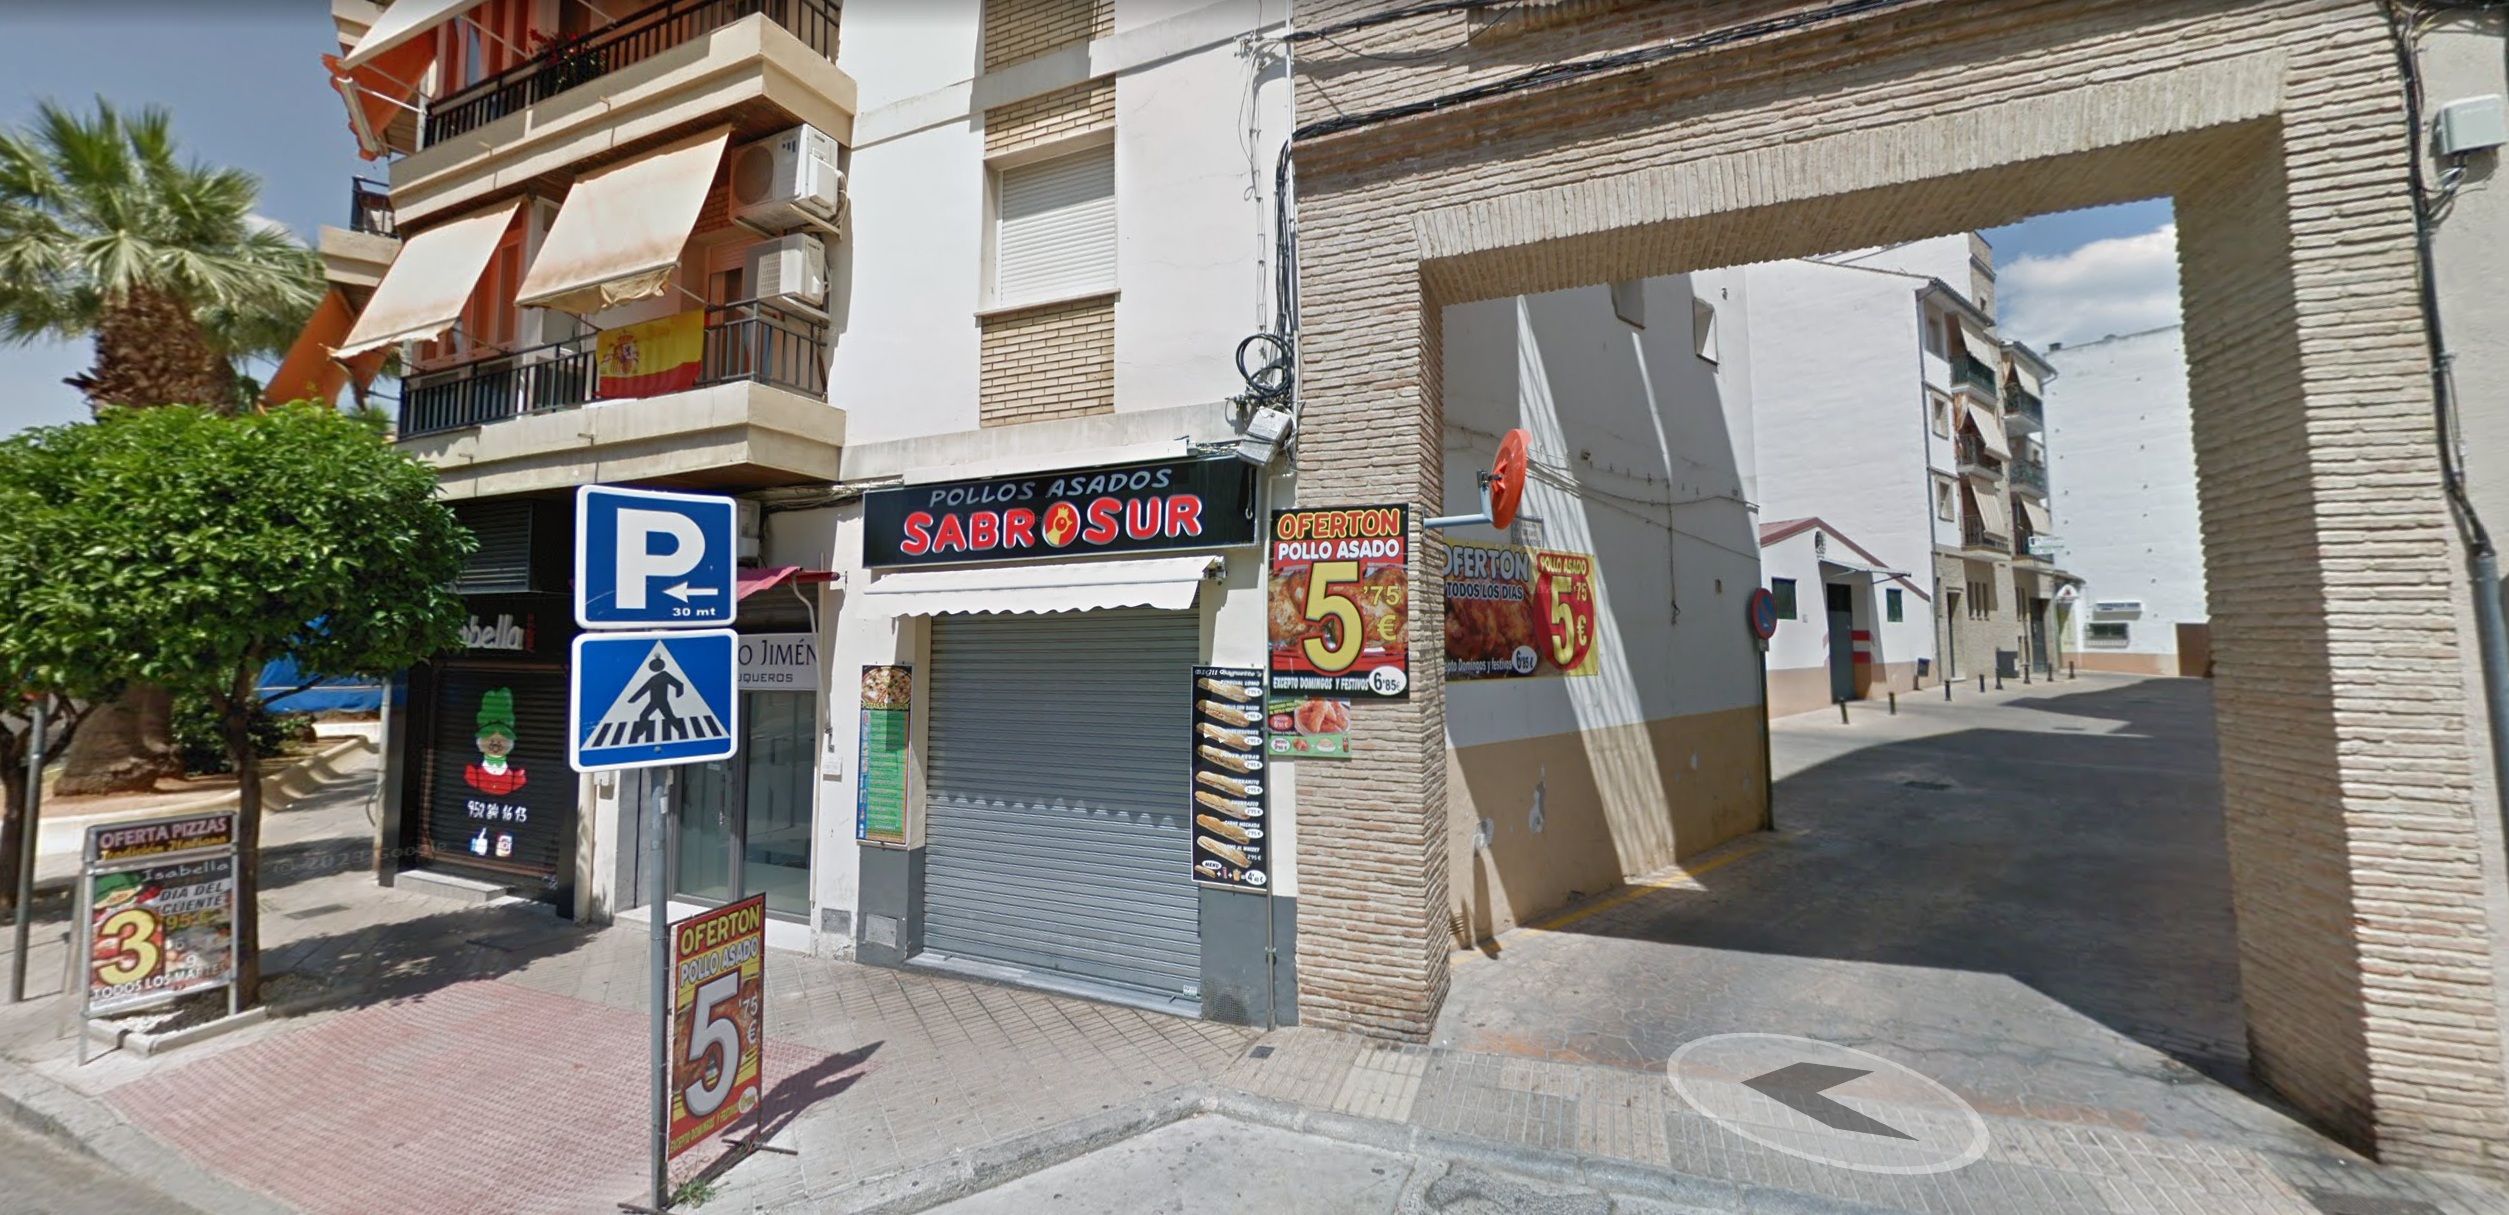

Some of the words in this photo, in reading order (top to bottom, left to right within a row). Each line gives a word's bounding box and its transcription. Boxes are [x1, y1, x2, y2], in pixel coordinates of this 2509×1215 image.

[929, 480, 1035, 508] POLLOS
[1045, 468, 1172, 498] ASADOS
[1277, 508, 1400, 540] OFERTON
[616, 508, 705, 609] P
[1278, 541, 1332, 561] POLLO
[1336, 539, 1399, 559] ASADO
[1540, 555, 1562, 573] POLLO
[1563, 557, 1587, 575] ASADO
[1446, 582, 1480, 598] TODOS
[1481, 583, 1500, 599] LOS
[1501, 585, 1524, 601] DIAS
[672, 607, 691, 616] 30
[696, 607, 716, 616] mt
[1303, 561, 1363, 672] 5
[1377, 615, 1397, 641] €
[1551, 575, 1575, 665] 5
[1576, 615, 1588, 646] €
[1458, 658, 1487, 673] Domingos
[1273, 677, 1298, 689] EXCEPTO
[1300, 677, 1332, 690] DOMINGOS
[1335, 678, 1340, 690] Y
[1341, 678, 1369, 691] FESTIVOS
[468, 800, 484, 818] 952
[100, 825, 169, 849] OFERTA
[171, 817, 227, 838] PIZZAS
[142, 861, 229, 882] Isabella
[160, 887, 189, 901] DIA
[195, 882, 223, 895] DEL
[161, 895, 222, 915] CLIENTE
[680, 904, 760, 956] OFERTON
[98, 909, 158, 985] 3
[680, 952, 719, 988] POLLO
[720, 937, 760, 971] ASADO
[92, 980, 141, 999] TODOS
[144, 973, 170, 989] LOS
[685, 970, 740, 1118] 5
[746, 1021, 758, 1045] €
